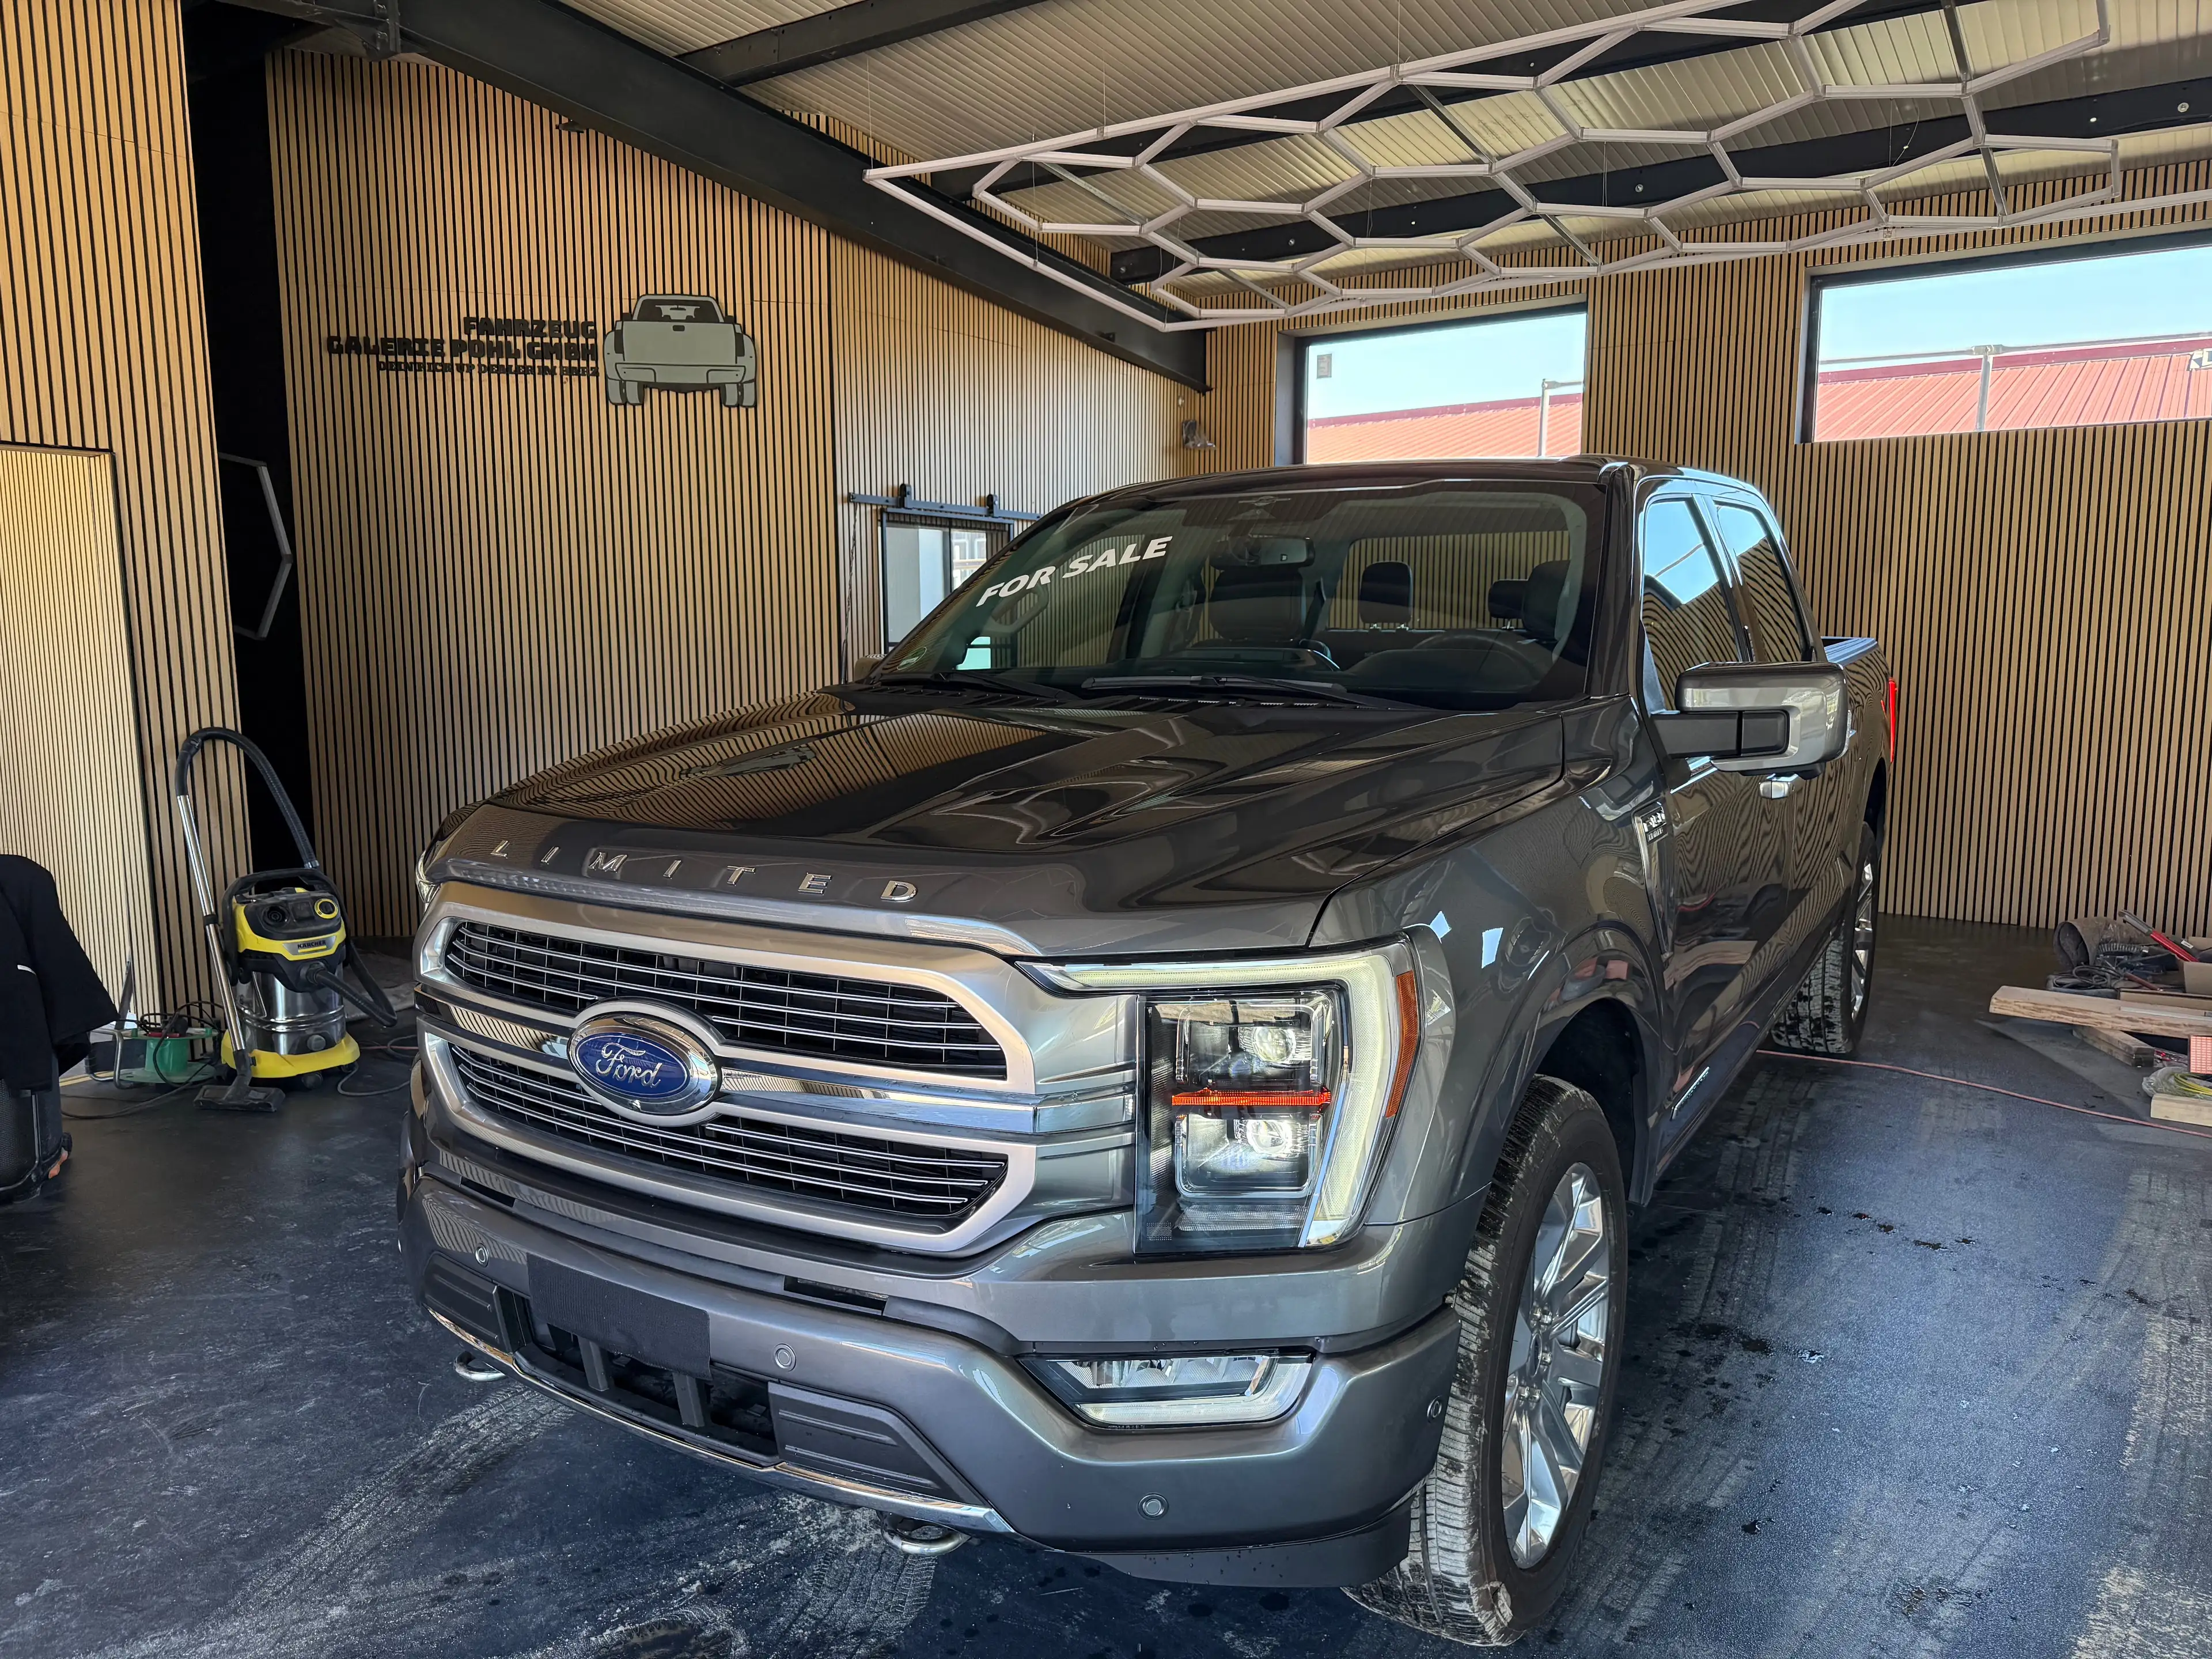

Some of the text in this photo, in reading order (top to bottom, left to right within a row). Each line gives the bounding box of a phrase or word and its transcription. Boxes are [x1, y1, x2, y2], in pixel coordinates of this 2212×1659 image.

[463, 317, 597, 339] FAHRZEUG
[327, 335, 597, 361] GALERIE POHL GMBH
[377, 361, 413, 372] DEIN
[455, 363, 475, 373] UP
[478, 363, 534, 375] DEALER
[537, 365, 557, 375] IM
[976, 536, 1173, 608] FOR SALE
[490, 839, 918, 902] LIMITED
[595, 1042, 662, 1088] Ford
